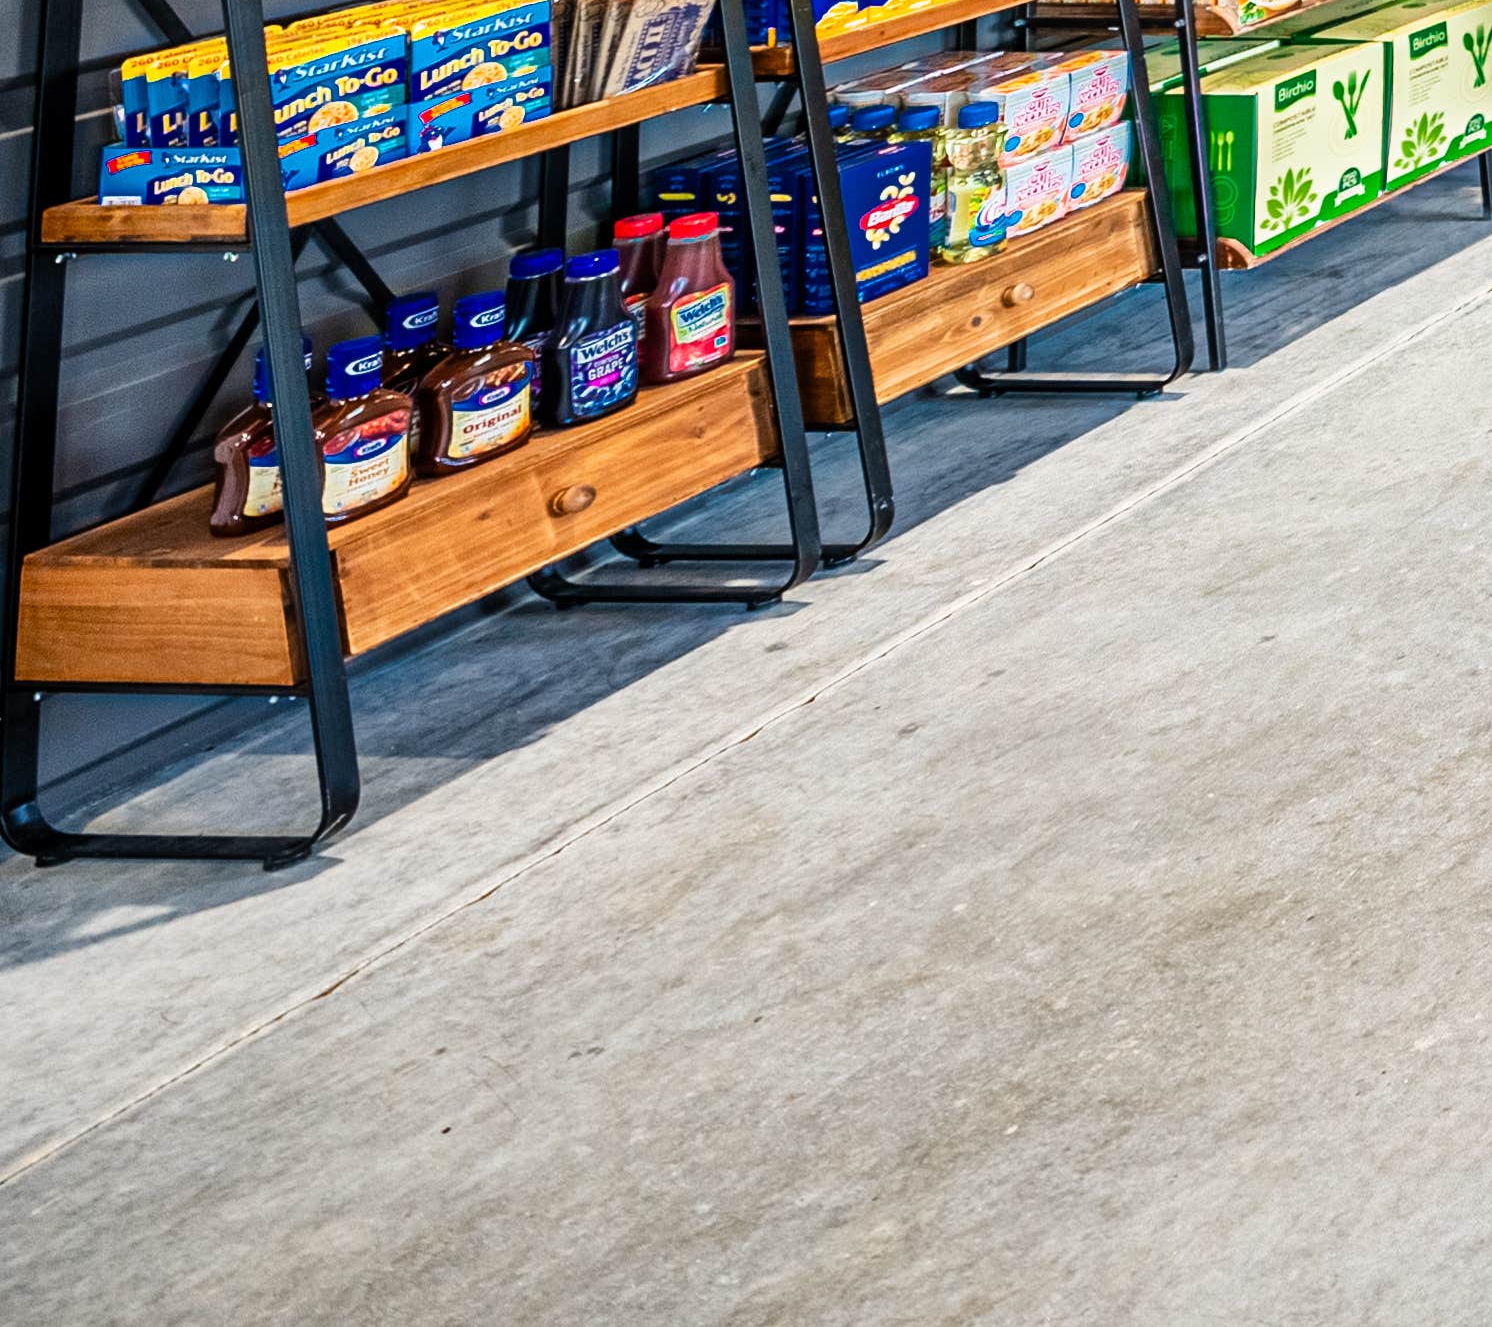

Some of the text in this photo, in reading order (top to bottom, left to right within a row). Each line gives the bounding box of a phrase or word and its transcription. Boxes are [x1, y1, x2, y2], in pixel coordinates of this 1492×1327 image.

[1412, 27, 1447, 51] Birchio
[420, 29, 543, 91] Lunch To-Go
[274, 66, 399, 124] unch To-Go
[1278, 77, 1315, 103] Birchio
[478, 95, 513, 122] Lunch
[326, 126, 401, 165] Lunch To-Go
[153, 167, 236, 196] Lunch To-Go
[679, 293, 725, 323] Welch's
[579, 327, 632, 360] Welch's
[588, 356, 624, 381] GRAPE
[462, 406, 523, 435] Original
[347, 466, 391, 488] Honey
[350, 458, 391, 478] Sweet
